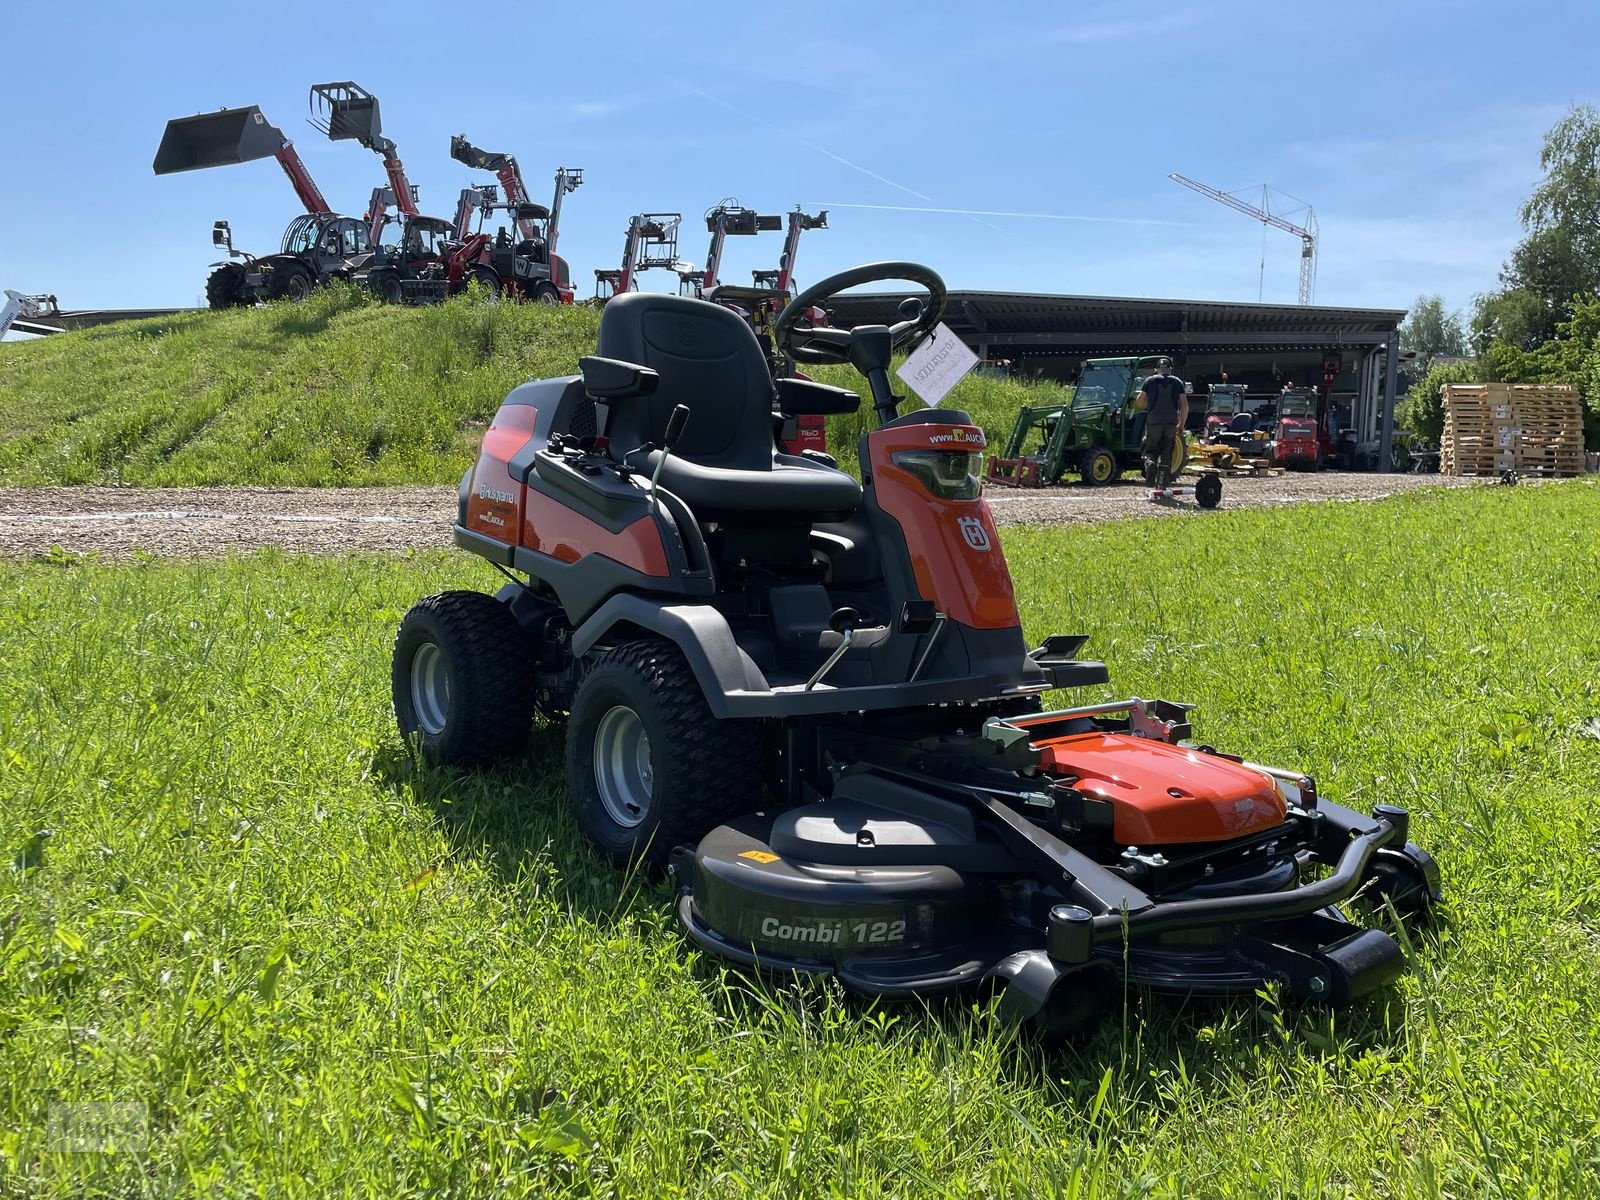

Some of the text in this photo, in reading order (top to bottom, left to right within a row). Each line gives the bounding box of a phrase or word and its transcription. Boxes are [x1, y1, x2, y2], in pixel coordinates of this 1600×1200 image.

[486, 487, 513, 503] Husqvarna
[761, 914, 907, 943] Combi 122
